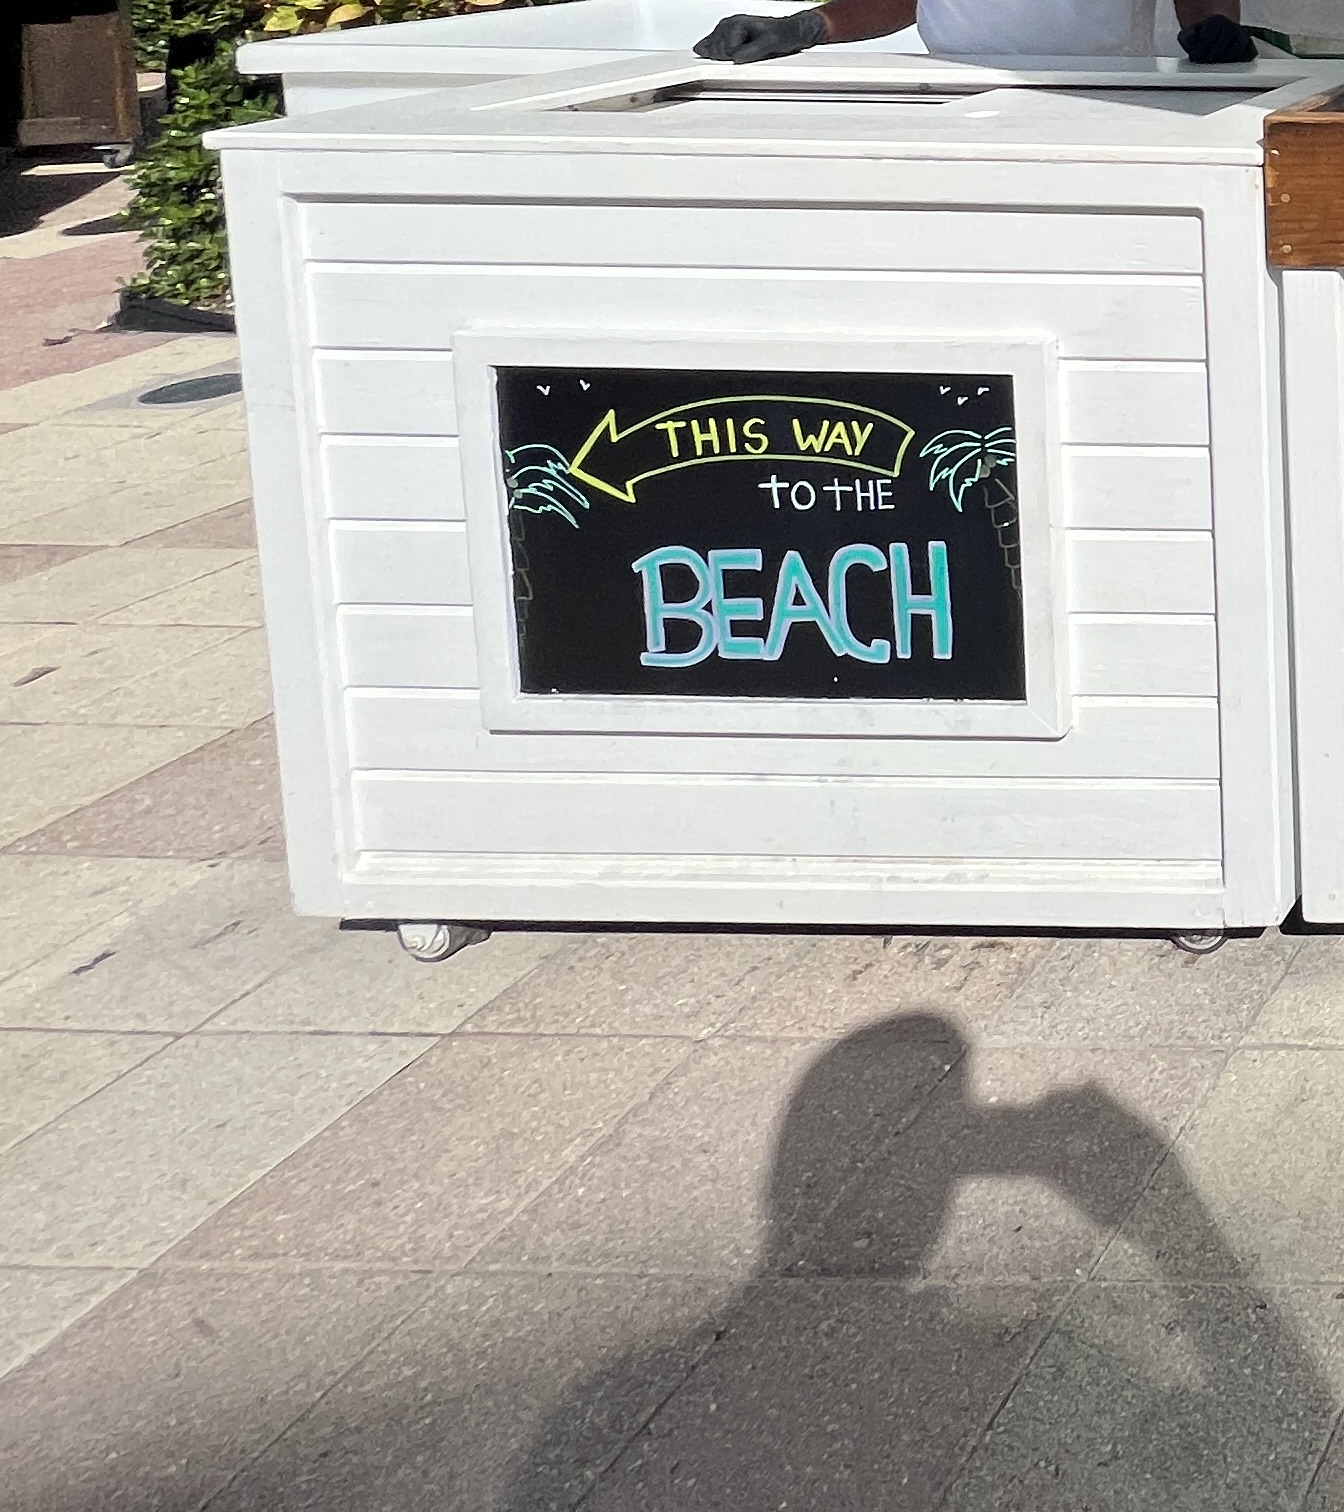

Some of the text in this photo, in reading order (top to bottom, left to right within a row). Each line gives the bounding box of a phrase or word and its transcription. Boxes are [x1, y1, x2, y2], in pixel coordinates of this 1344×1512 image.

[655, 416, 875, 458] THIS WAY
[632, 539, 954, 669] BEACH
